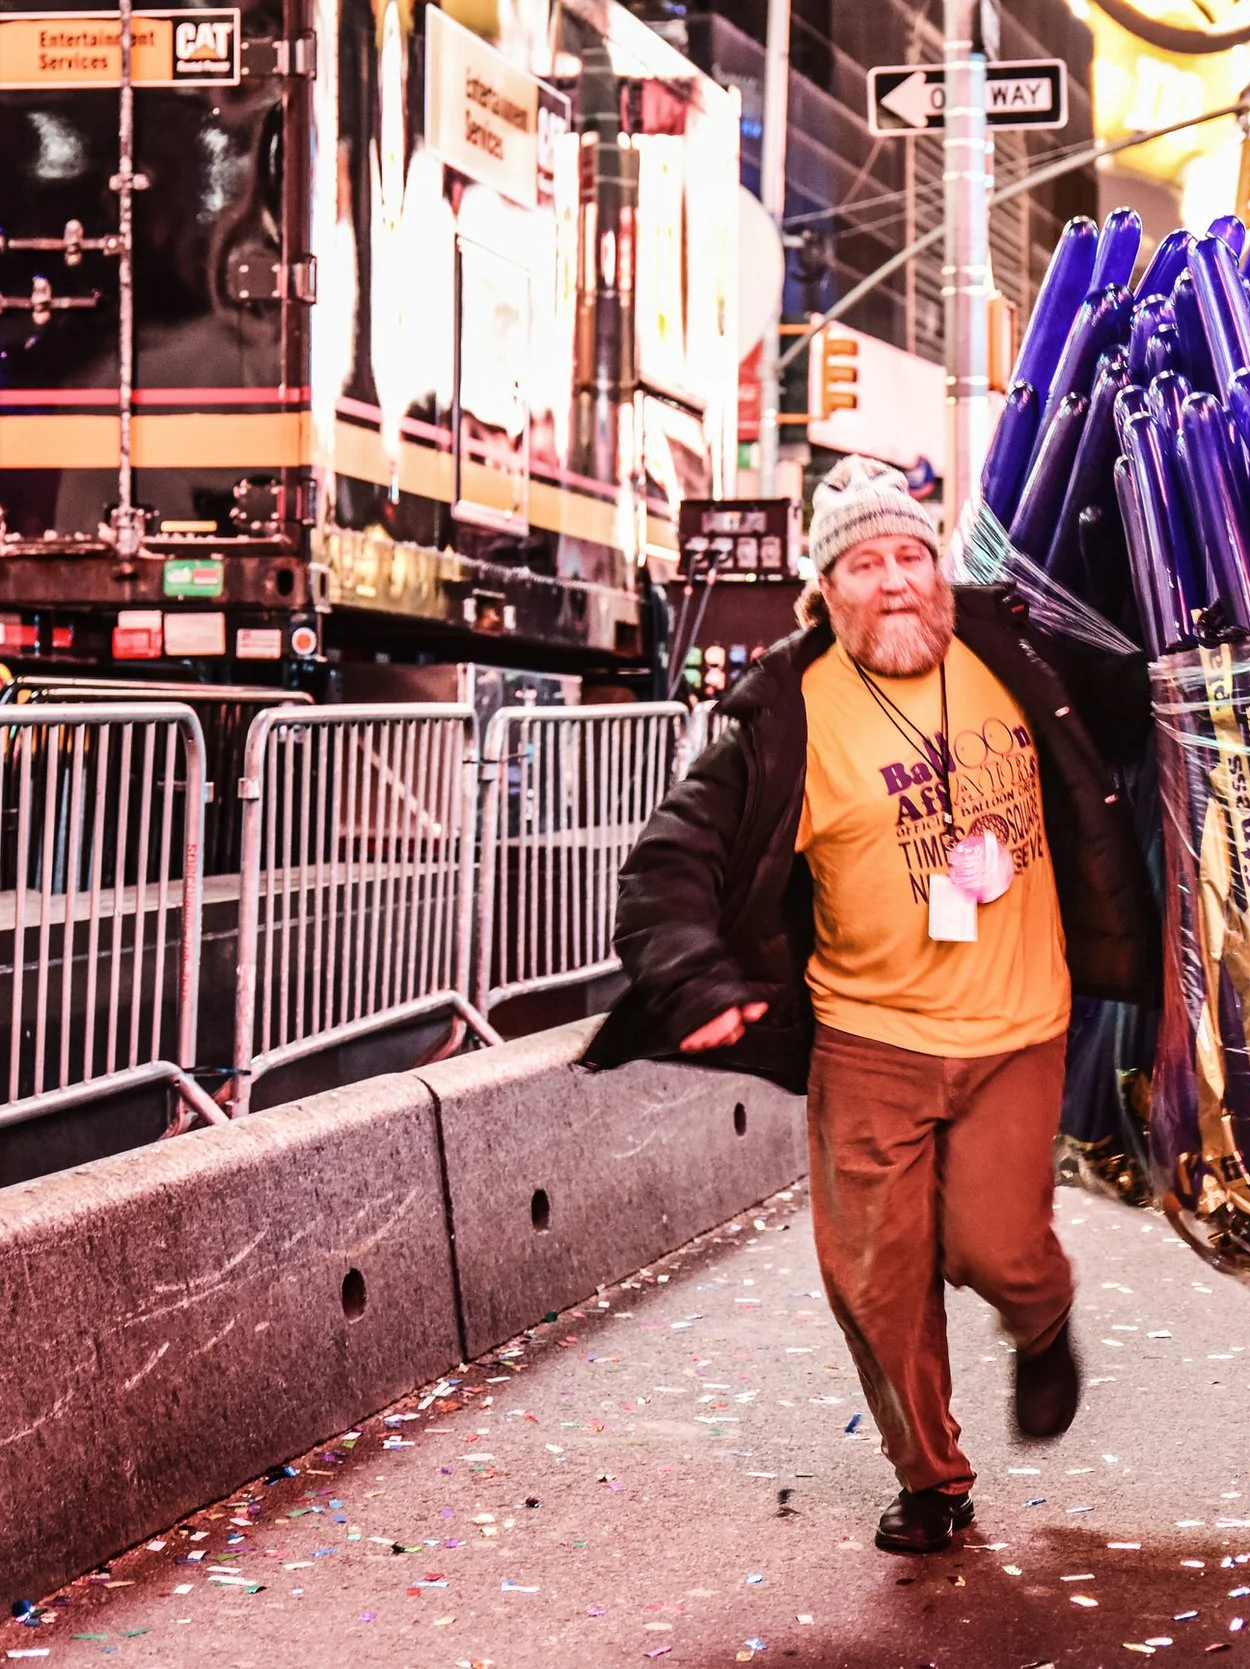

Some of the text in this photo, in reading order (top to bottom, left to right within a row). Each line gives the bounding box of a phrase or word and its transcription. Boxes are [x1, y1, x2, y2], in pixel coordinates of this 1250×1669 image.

[175, 22, 233, 59] CAT
[39, 53, 108, 70] Services
[991, 83, 1042, 107] WAY
[895, 816, 952, 838] OFFICI
[960, 789, 1015, 817] BALLOON
